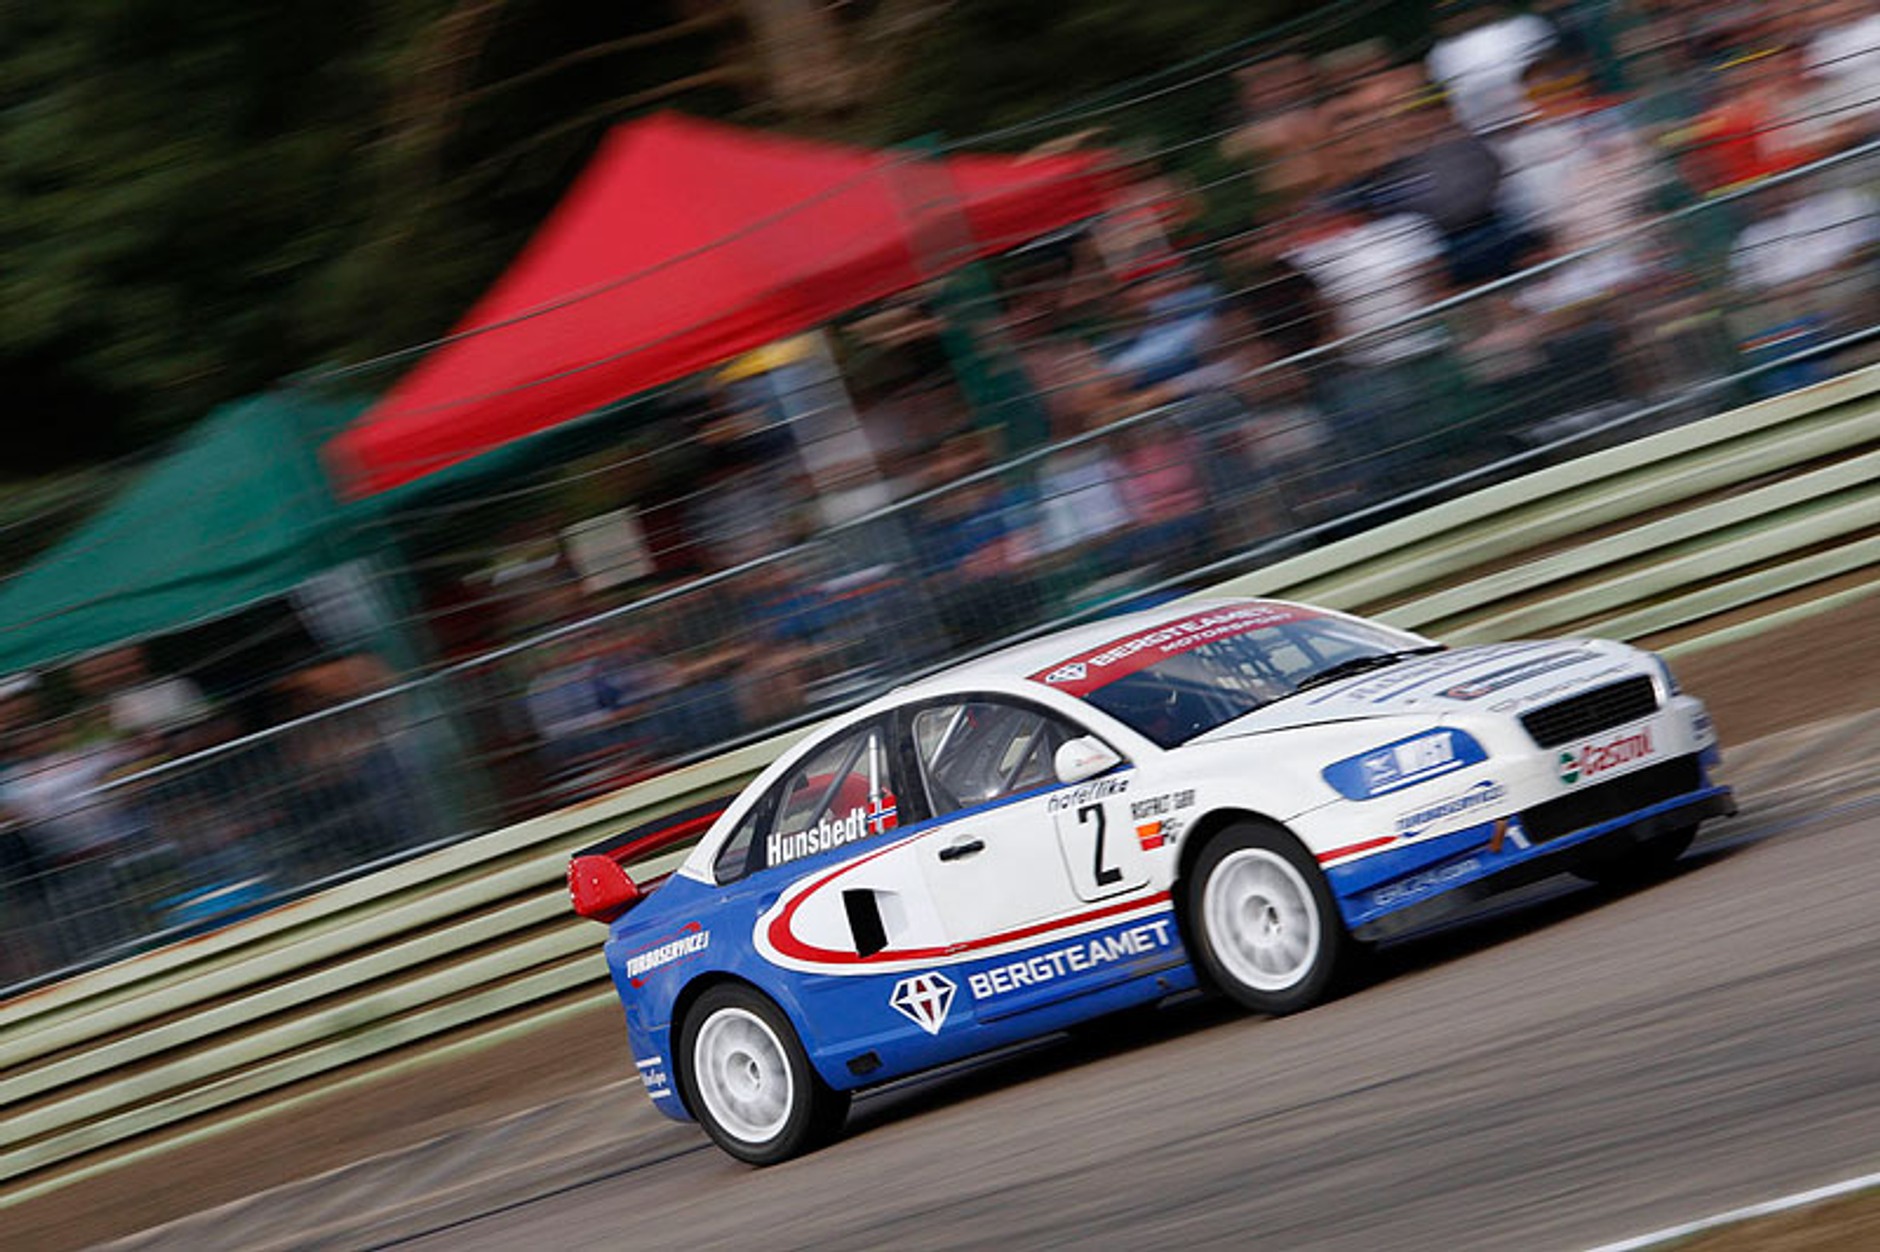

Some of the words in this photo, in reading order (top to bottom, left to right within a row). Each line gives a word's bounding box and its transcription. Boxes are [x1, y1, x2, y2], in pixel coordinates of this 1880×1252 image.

[1088, 607, 1276, 666] BERGTEAMET
[1160, 612, 1293, 652] MOTORSPORT
[1581, 725, 1654, 776] Castrol
[767, 806, 868, 868] Hunsbedt
[1077, 802, 1124, 887] 2
[968, 919, 1170, 1000] BERGTEAMET
